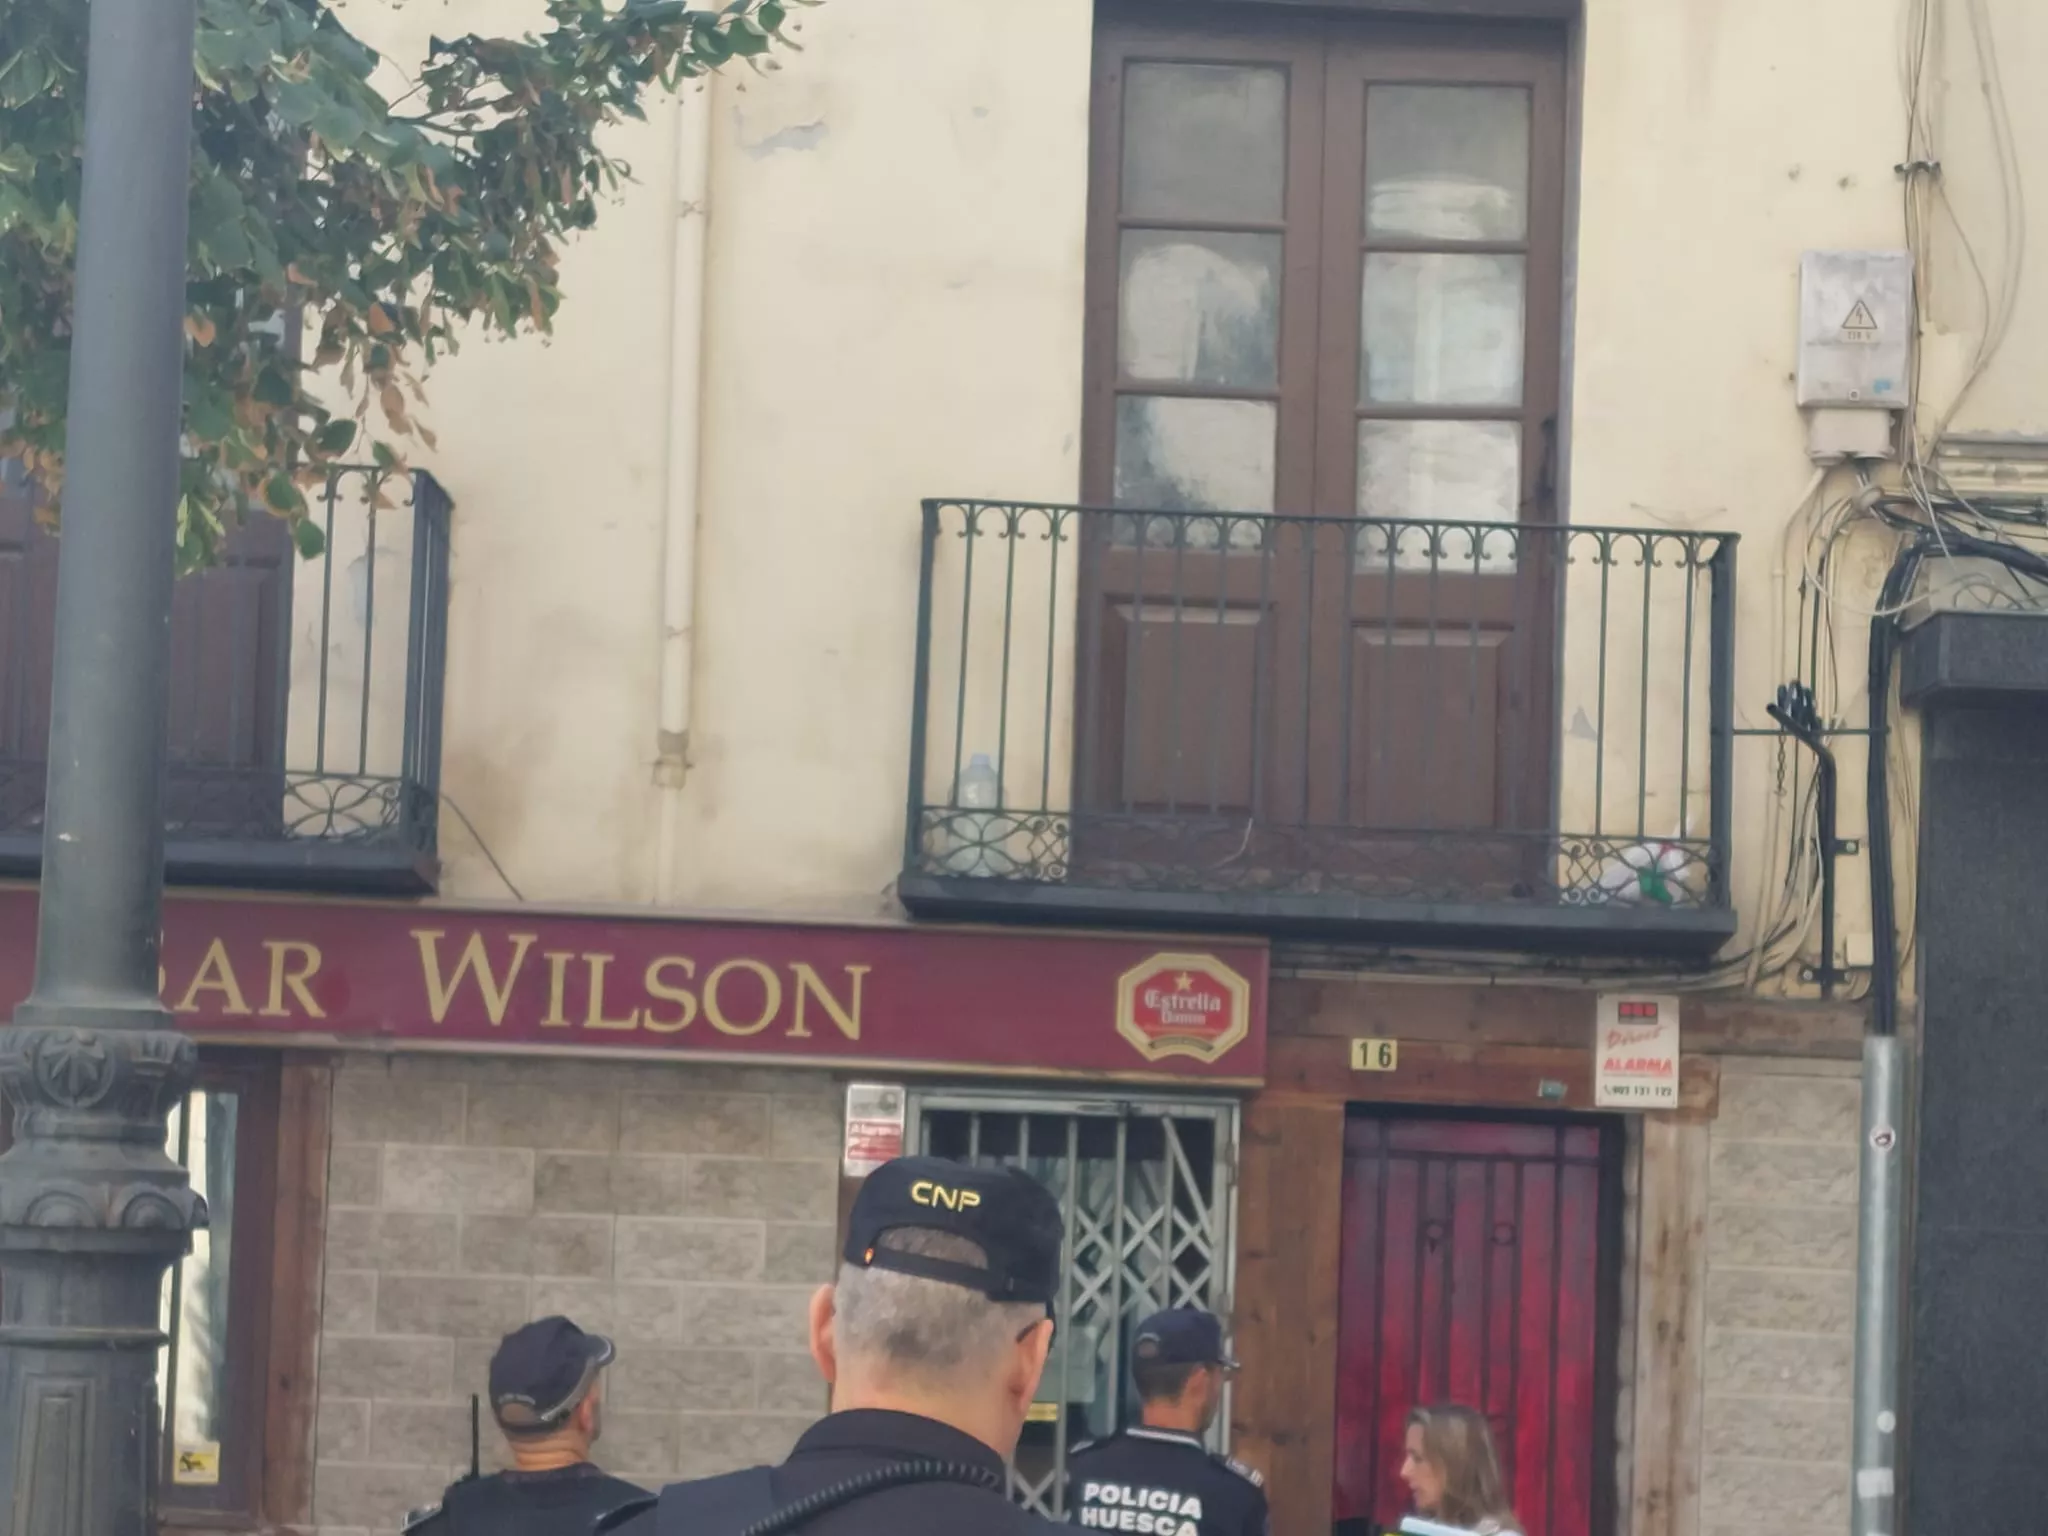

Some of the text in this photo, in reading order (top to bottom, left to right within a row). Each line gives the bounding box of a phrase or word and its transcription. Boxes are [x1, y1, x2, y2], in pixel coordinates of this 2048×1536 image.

[158, 929, 872, 1041] AR WILSON
[1144, 989, 1221, 1012] Estrella
[1359, 1041, 1392, 1068] 16
[1603, 1057, 1673, 1075] ALARMA
[911, 1181, 981, 1212] CNP
[1084, 1483, 1202, 1519] POLICIA
[1081, 1507, 1200, 1536] HUESCA
